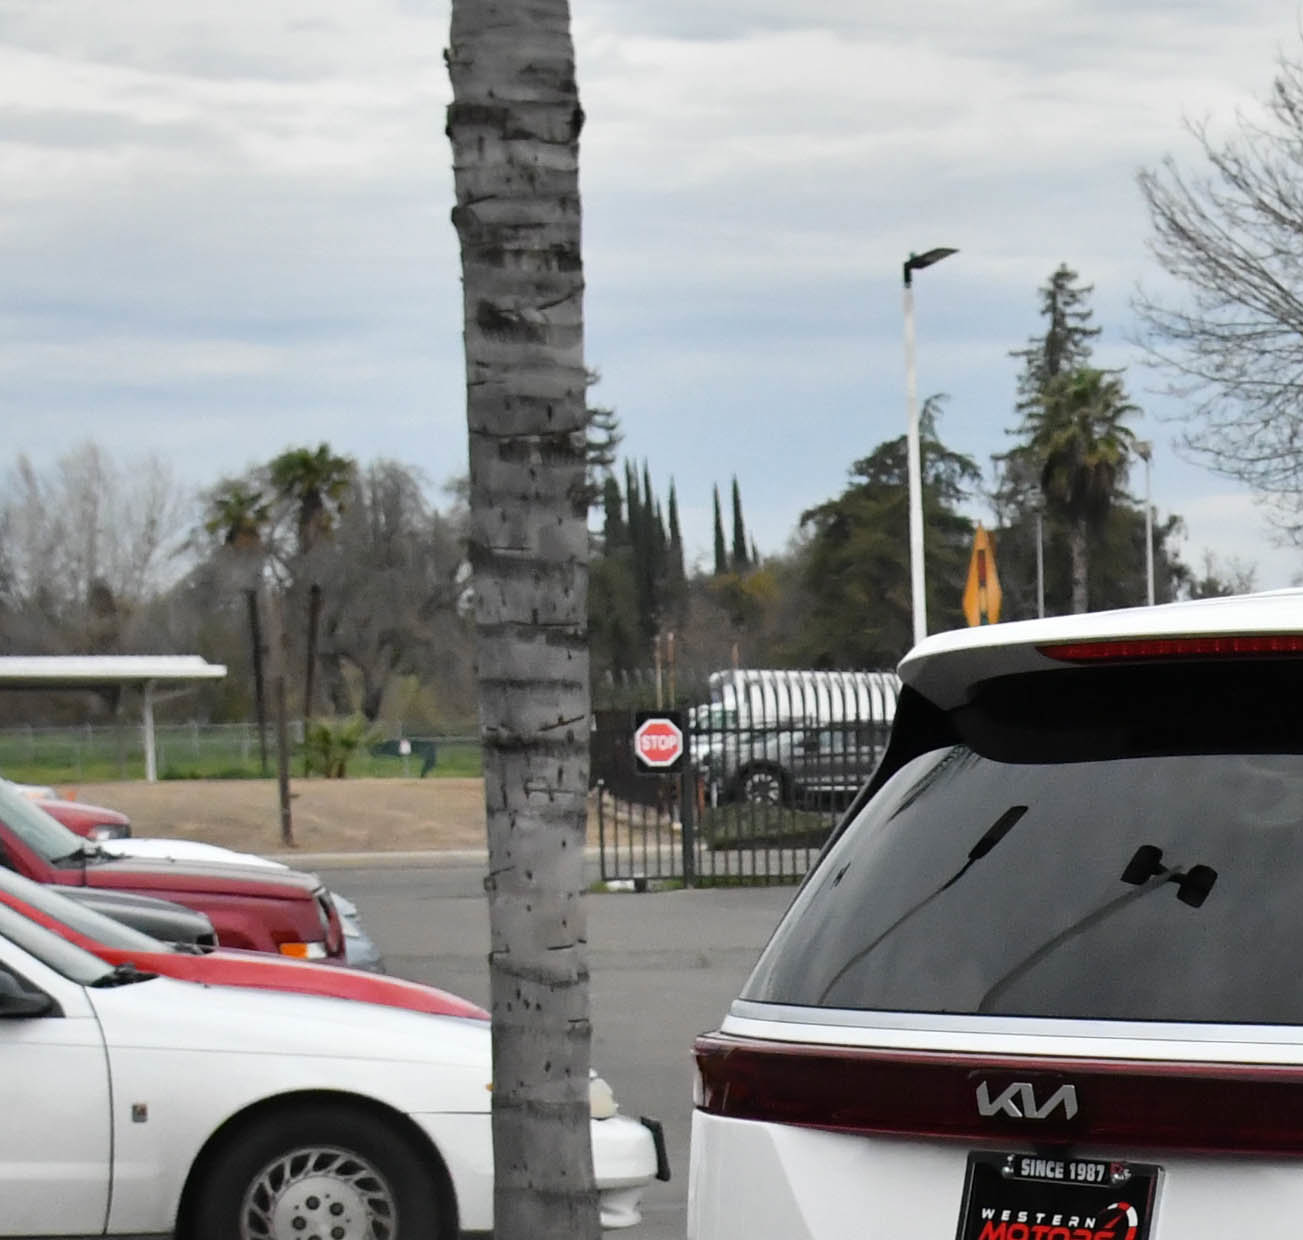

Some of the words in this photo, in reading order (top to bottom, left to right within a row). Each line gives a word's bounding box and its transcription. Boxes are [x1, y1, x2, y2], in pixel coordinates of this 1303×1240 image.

[640, 733, 677, 750] STOP
[975, 1081, 1078, 1120] KIA
[1021, 1158, 1064, 1179] SINCE
[1069, 1162, 1105, 1182] 1987
[981, 1208, 1097, 1228] WESTERN
